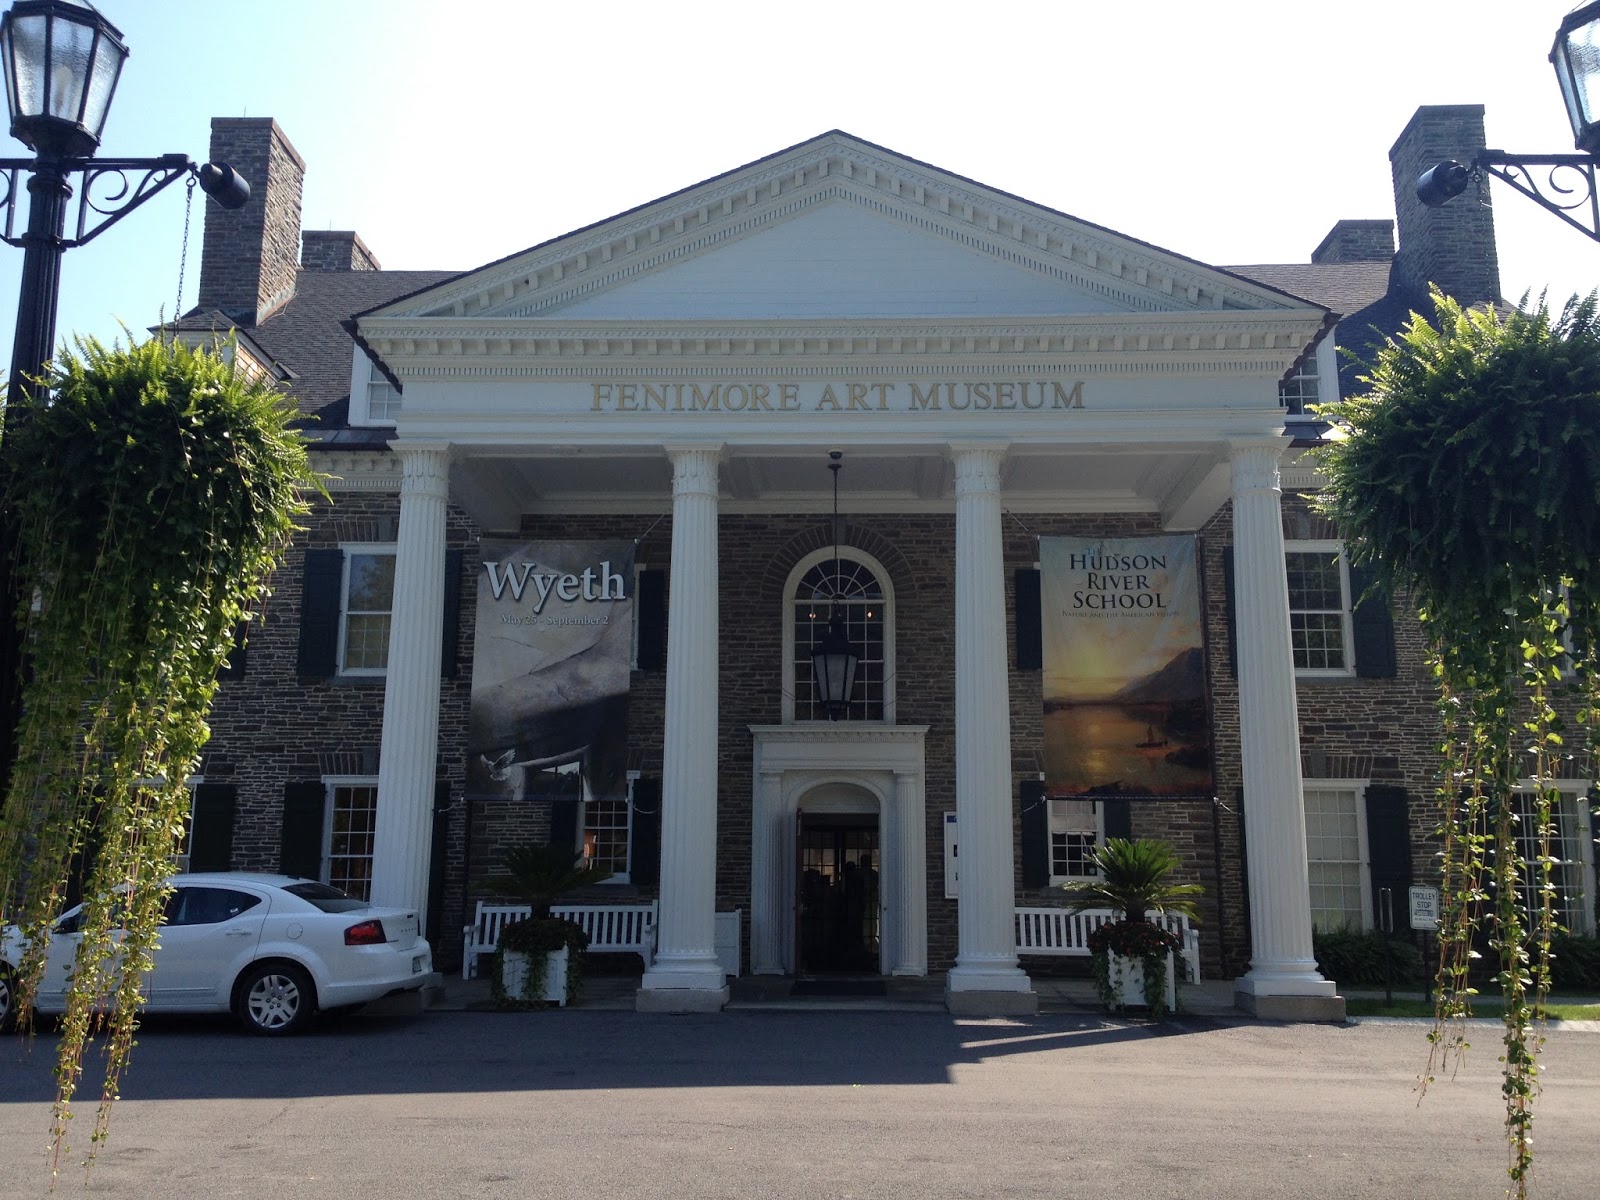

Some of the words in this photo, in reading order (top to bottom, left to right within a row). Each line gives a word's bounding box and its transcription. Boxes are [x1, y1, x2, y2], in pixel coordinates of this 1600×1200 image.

[590, 382, 800, 411] FENIMORE
[814, 382, 896, 411] ART
[908, 381, 1086, 411] MUSEUM
[1070, 553, 1167, 571] HUDSON
[482, 560, 627, 614] Wyeth
[1087, 572, 1151, 590] RIVER
[1073, 591, 1167, 610] SCHOOL
[501, 614, 524, 627] May
[526, 614, 538, 626] 25
[547, 614, 601, 628] September
[602, 614, 609, 626] 2
[1412, 892, 1436, 900] TROLLEY
[1416, 901, 1432, 909] STOP
